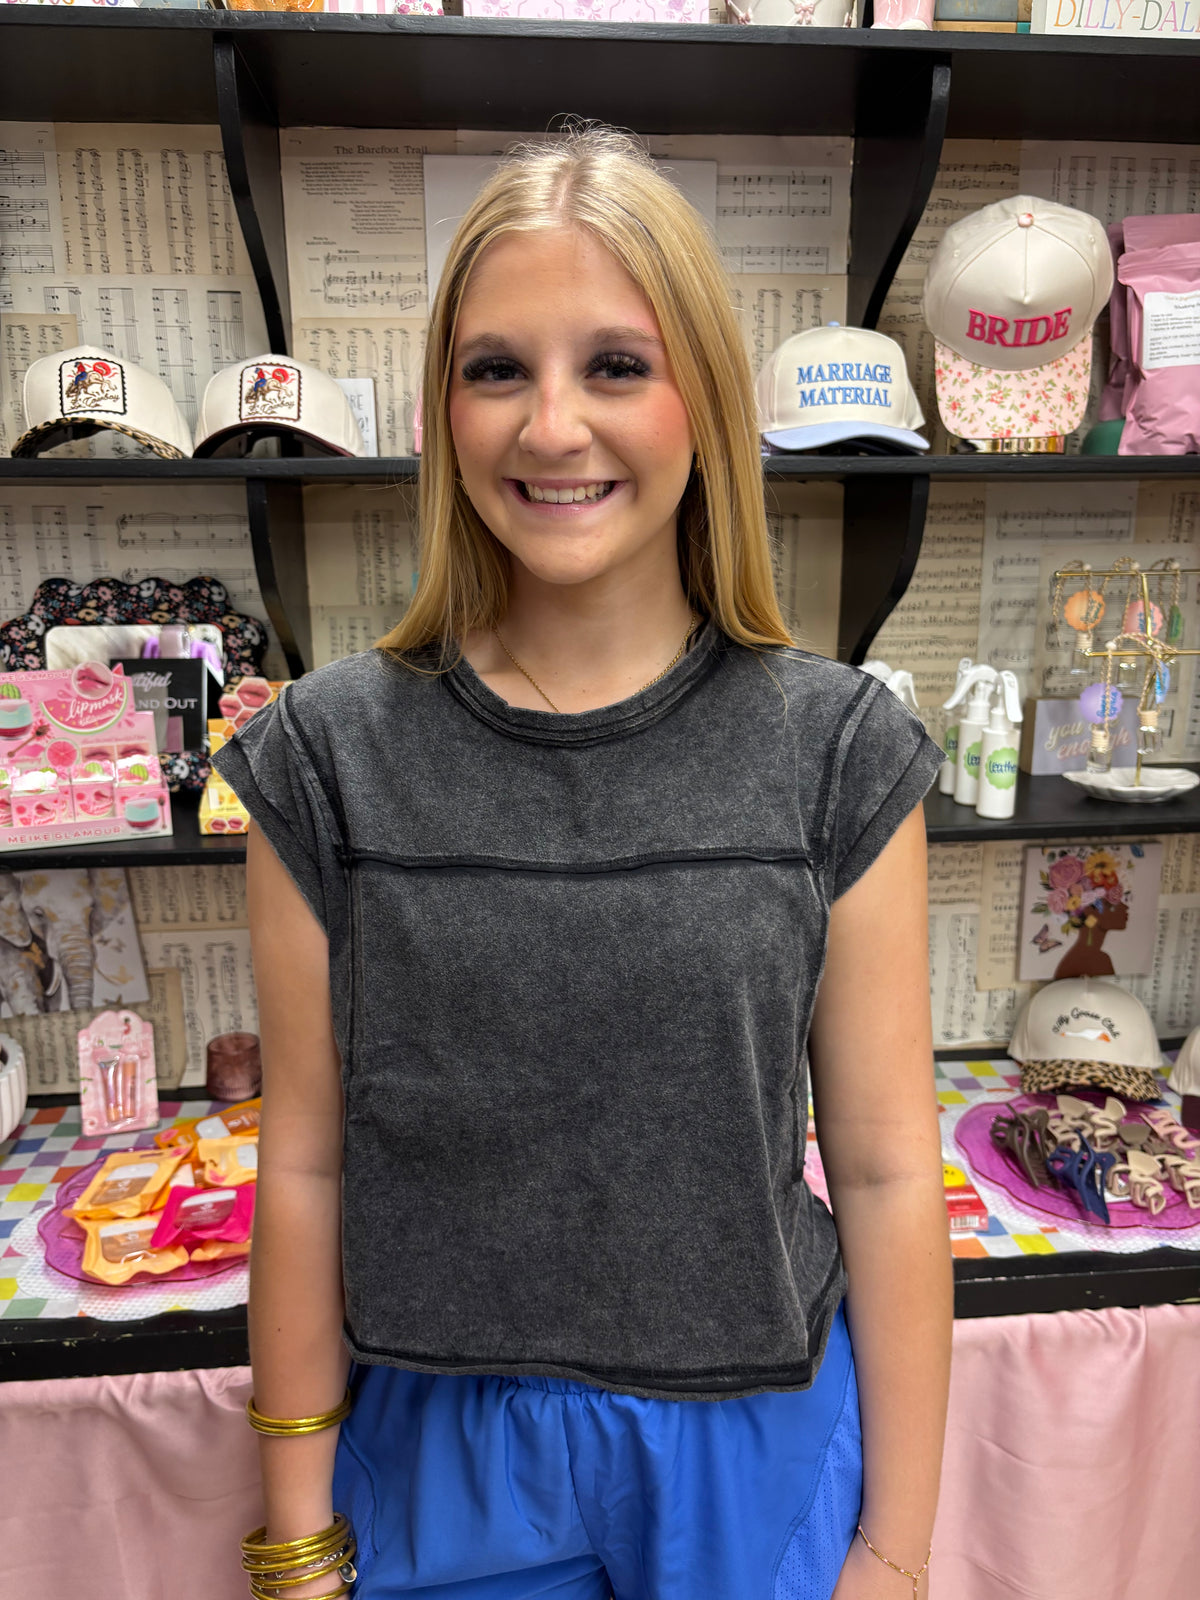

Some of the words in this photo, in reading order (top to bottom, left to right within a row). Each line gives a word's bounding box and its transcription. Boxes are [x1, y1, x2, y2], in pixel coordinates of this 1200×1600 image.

[1053, 0, 1200, 33] DILLY-DAL
[334, 145, 353, 155] The
[357, 145, 399, 154] Barefoot
[965, 306, 1073, 348] BRIDE
[796, 362, 893, 385] MARRIAGE
[798, 386, 892, 408] MATERIAL
[164, 697, 198, 709] OUT
[1044, 721, 1084, 751] you
